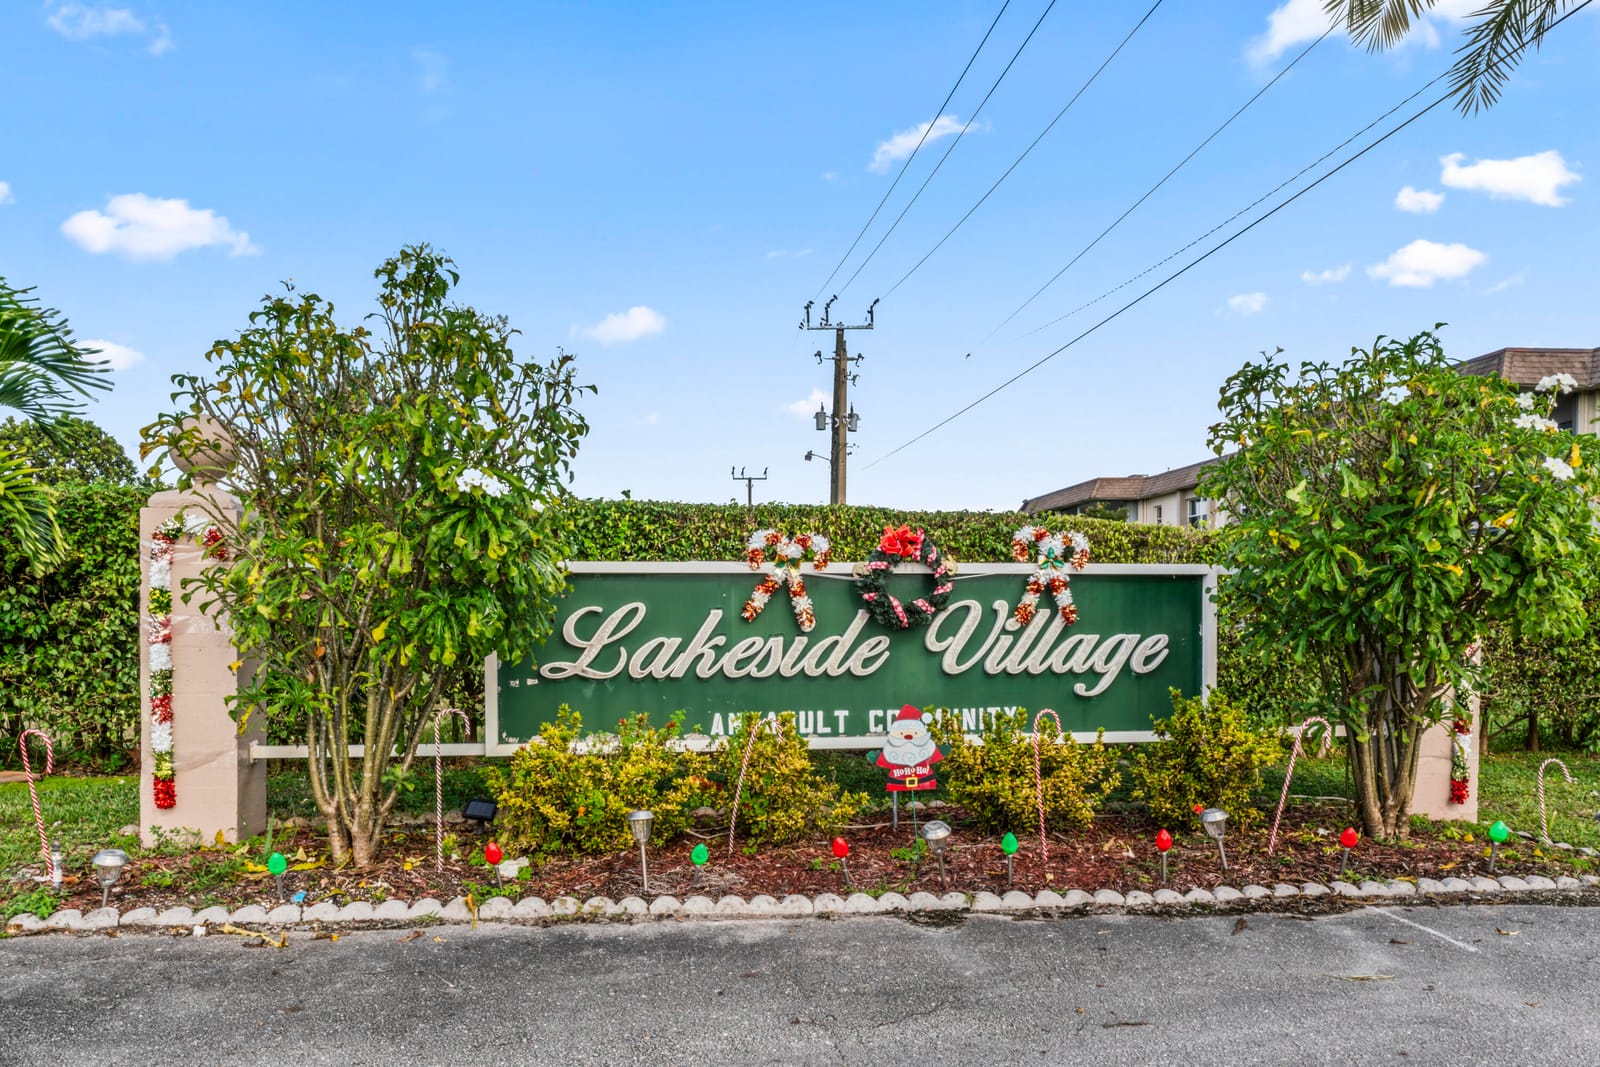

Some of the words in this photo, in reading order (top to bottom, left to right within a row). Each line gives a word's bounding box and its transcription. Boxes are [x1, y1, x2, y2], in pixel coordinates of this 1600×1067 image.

[540, 601, 890, 679] Lakeside
[924, 600, 1169, 698] Village
[763, 710, 849, 735] AULT
